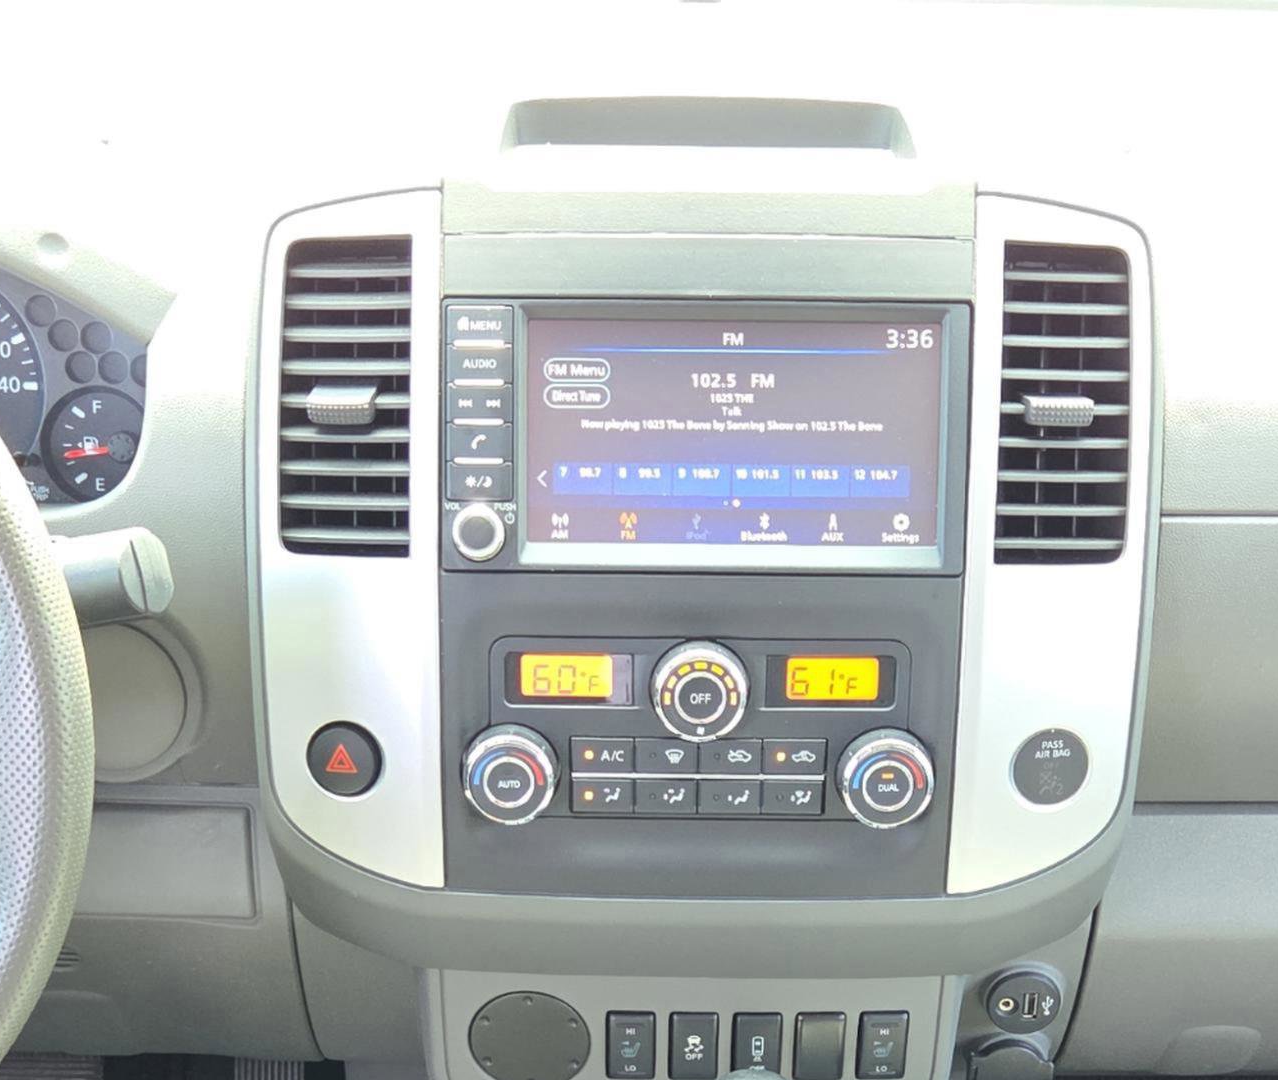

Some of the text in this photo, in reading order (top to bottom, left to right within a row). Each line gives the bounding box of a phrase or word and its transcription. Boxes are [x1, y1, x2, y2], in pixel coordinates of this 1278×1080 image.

[470, 321, 502, 331] MENU
[722, 332, 744, 346] FM
[885, 328, 934, 349] 3:36
[463, 359, 497, 369] AUDIO
[548, 363, 606, 376] FM Menu
[691, 372, 776, 389] 102.5 FM
[92, 401, 102, 414] F
[96, 478, 105, 492] E
[494, 503, 517, 511] PUSH
[551, 529, 569, 540] AM
[620, 530, 636, 541] FM
[821, 532, 844, 543] AUX
[690, 692, 712, 705] OFF
[1041, 740, 1064, 750] PASS
[600, 750, 625, 763] A/C
[1034, 748, 1071, 760] AIR BAG
[497, 779, 521, 789] AUTO
[878, 783, 900, 793] DUAL
[625, 1027, 636, 1036] HI
[879, 1028, 890, 1036] HI
[685, 1053, 703, 1061] OFF
[624, 1064, 637, 1072] LO
